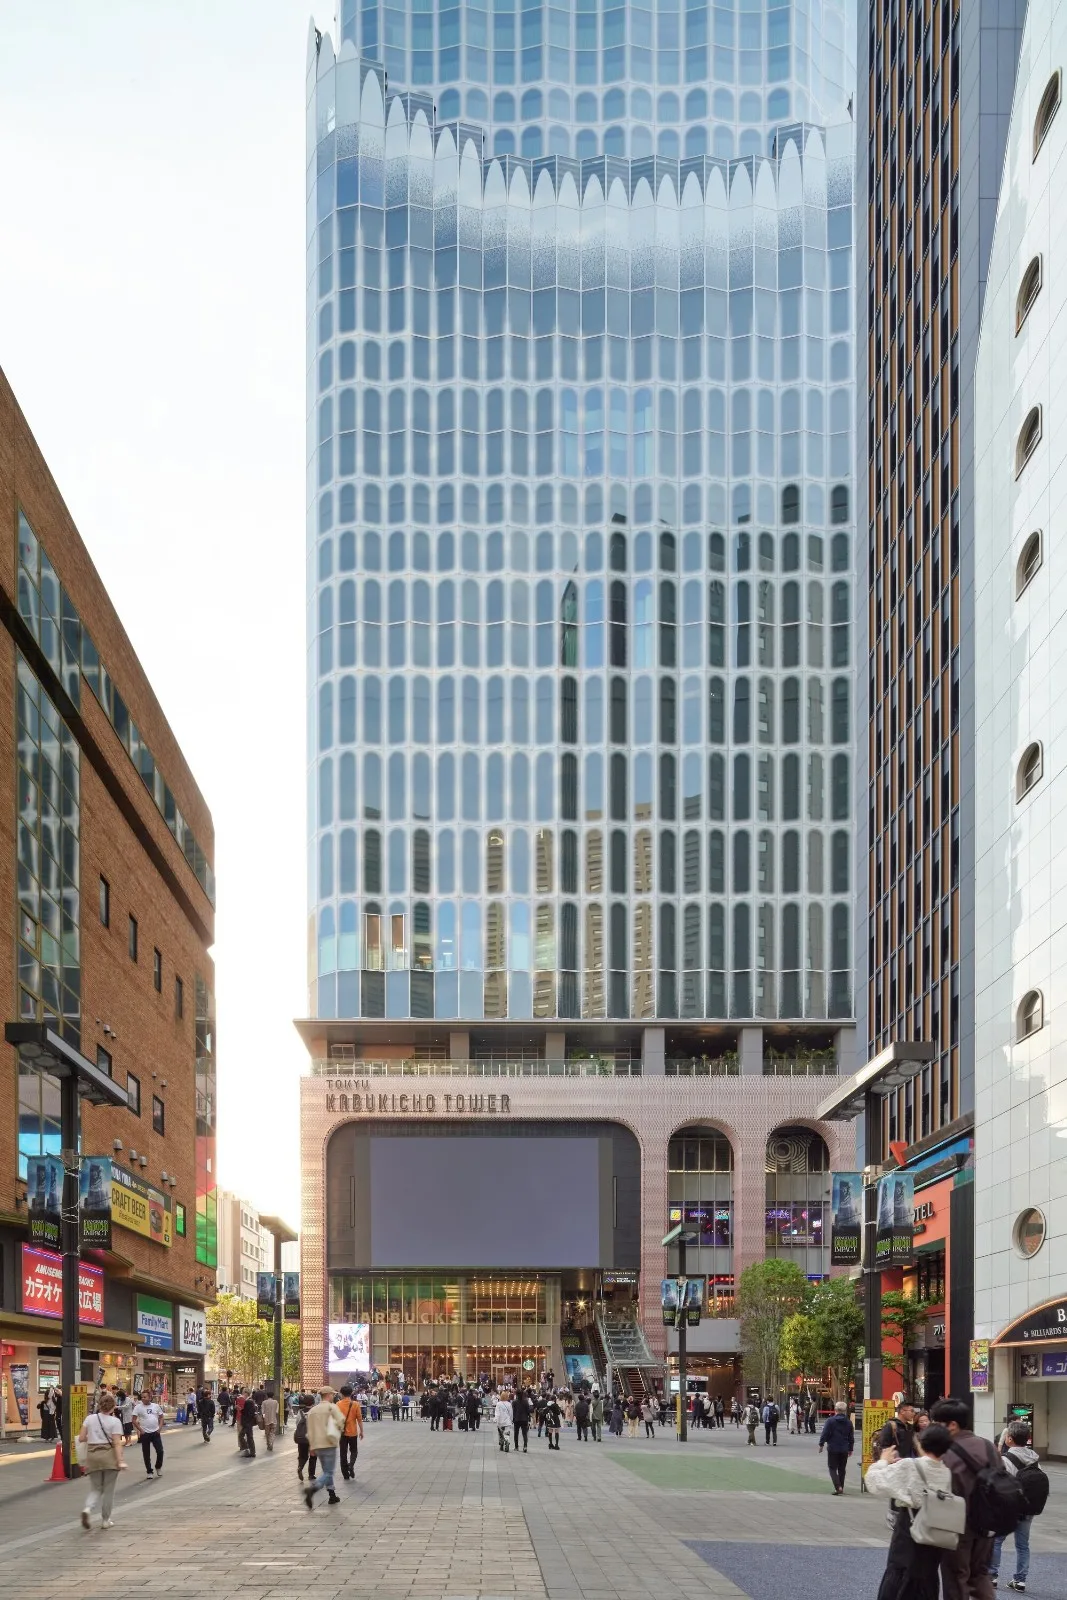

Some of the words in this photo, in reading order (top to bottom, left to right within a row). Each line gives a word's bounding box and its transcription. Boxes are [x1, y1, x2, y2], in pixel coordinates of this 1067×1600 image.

[326, 1079, 370, 1089] TOKYU
[326, 1094, 436, 1112] KABUKICHO
[443, 1094, 511, 1112] TOWER
[111, 1187, 131, 1212] CRAFT
[132, 1199, 146, 1220] BEER
[914, 1201, 934, 1222] TEL
[25, 1276, 62, 1303] カラオケ
[141, 1314, 169, 1330] FamilyMart
[1030, 1326, 1062, 1338] BILLIARDS
